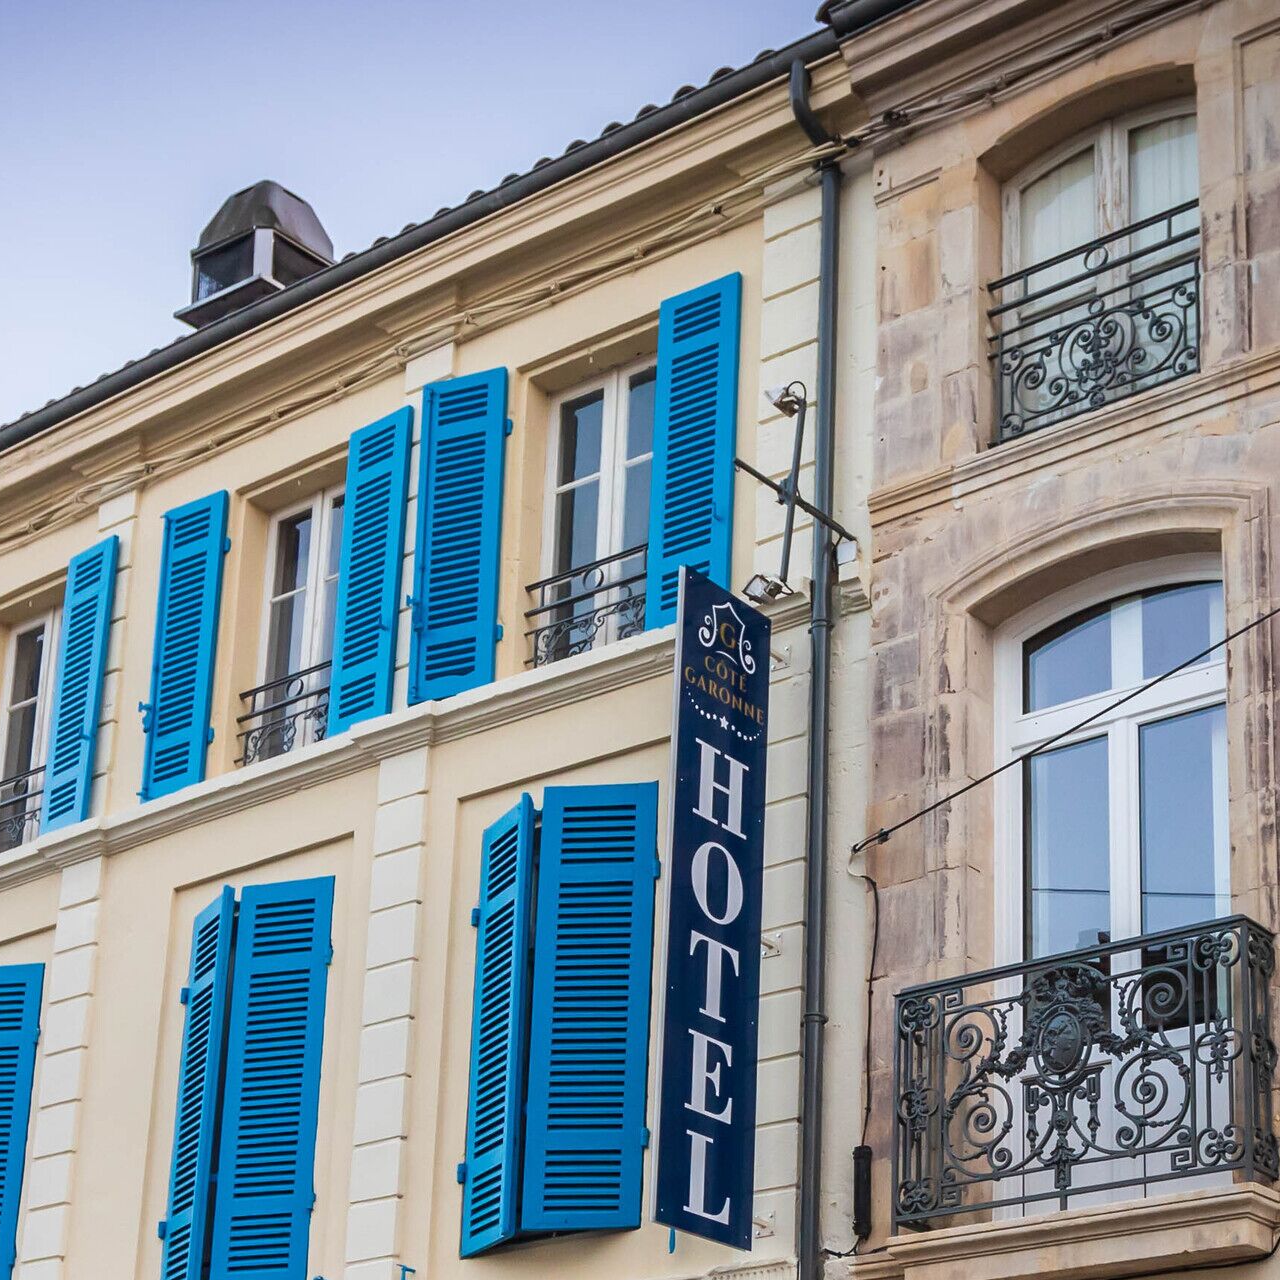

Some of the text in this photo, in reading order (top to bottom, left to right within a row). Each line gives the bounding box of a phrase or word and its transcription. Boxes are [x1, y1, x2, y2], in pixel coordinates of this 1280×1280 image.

[720, 623, 738, 650] G
[684, 666, 766, 725] GARONNE
[704, 655, 748, 693] CÔTÉ
[683, 737, 750, 1226] HOTEL
